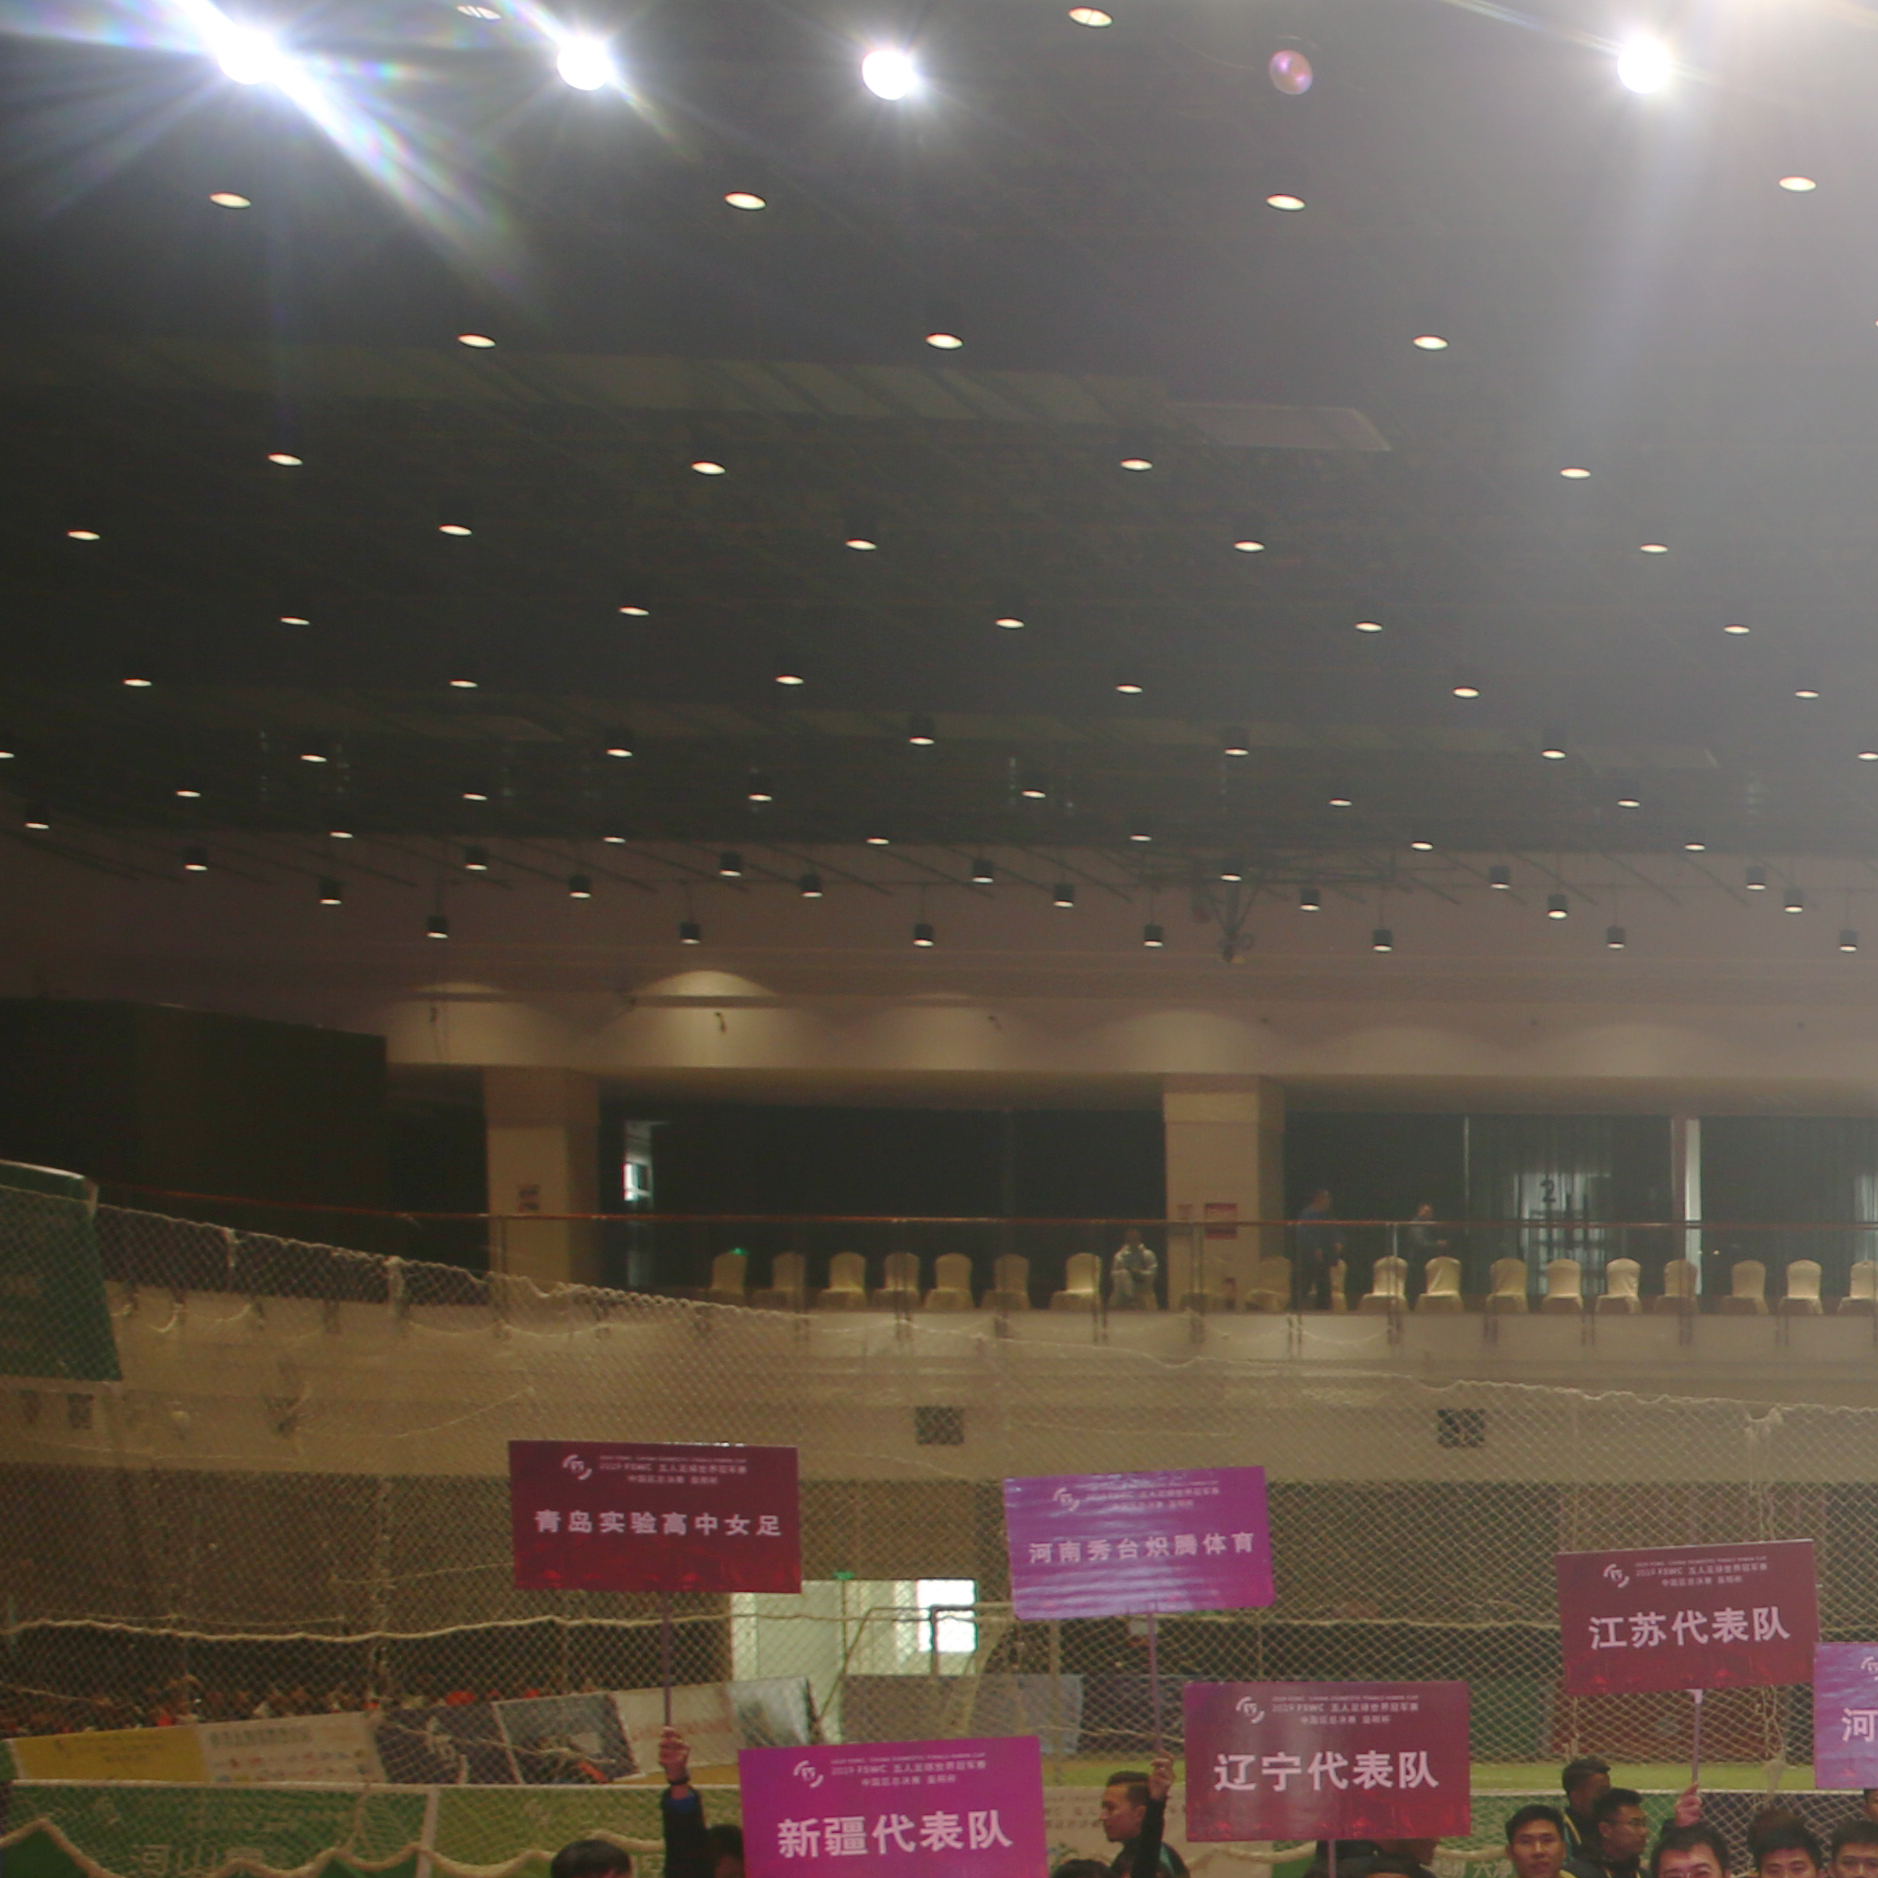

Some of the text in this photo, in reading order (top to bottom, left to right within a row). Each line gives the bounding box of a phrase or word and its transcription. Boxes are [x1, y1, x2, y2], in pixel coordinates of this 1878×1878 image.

[534, 1509, 782, 1537] 青岛实验高中女足
[1588, 1606, 1791, 1650] 江苏代表队
[1213, 1749, 1439, 1792] 辽宁代表队
[777, 1809, 1013, 1859] 新疆代表队
